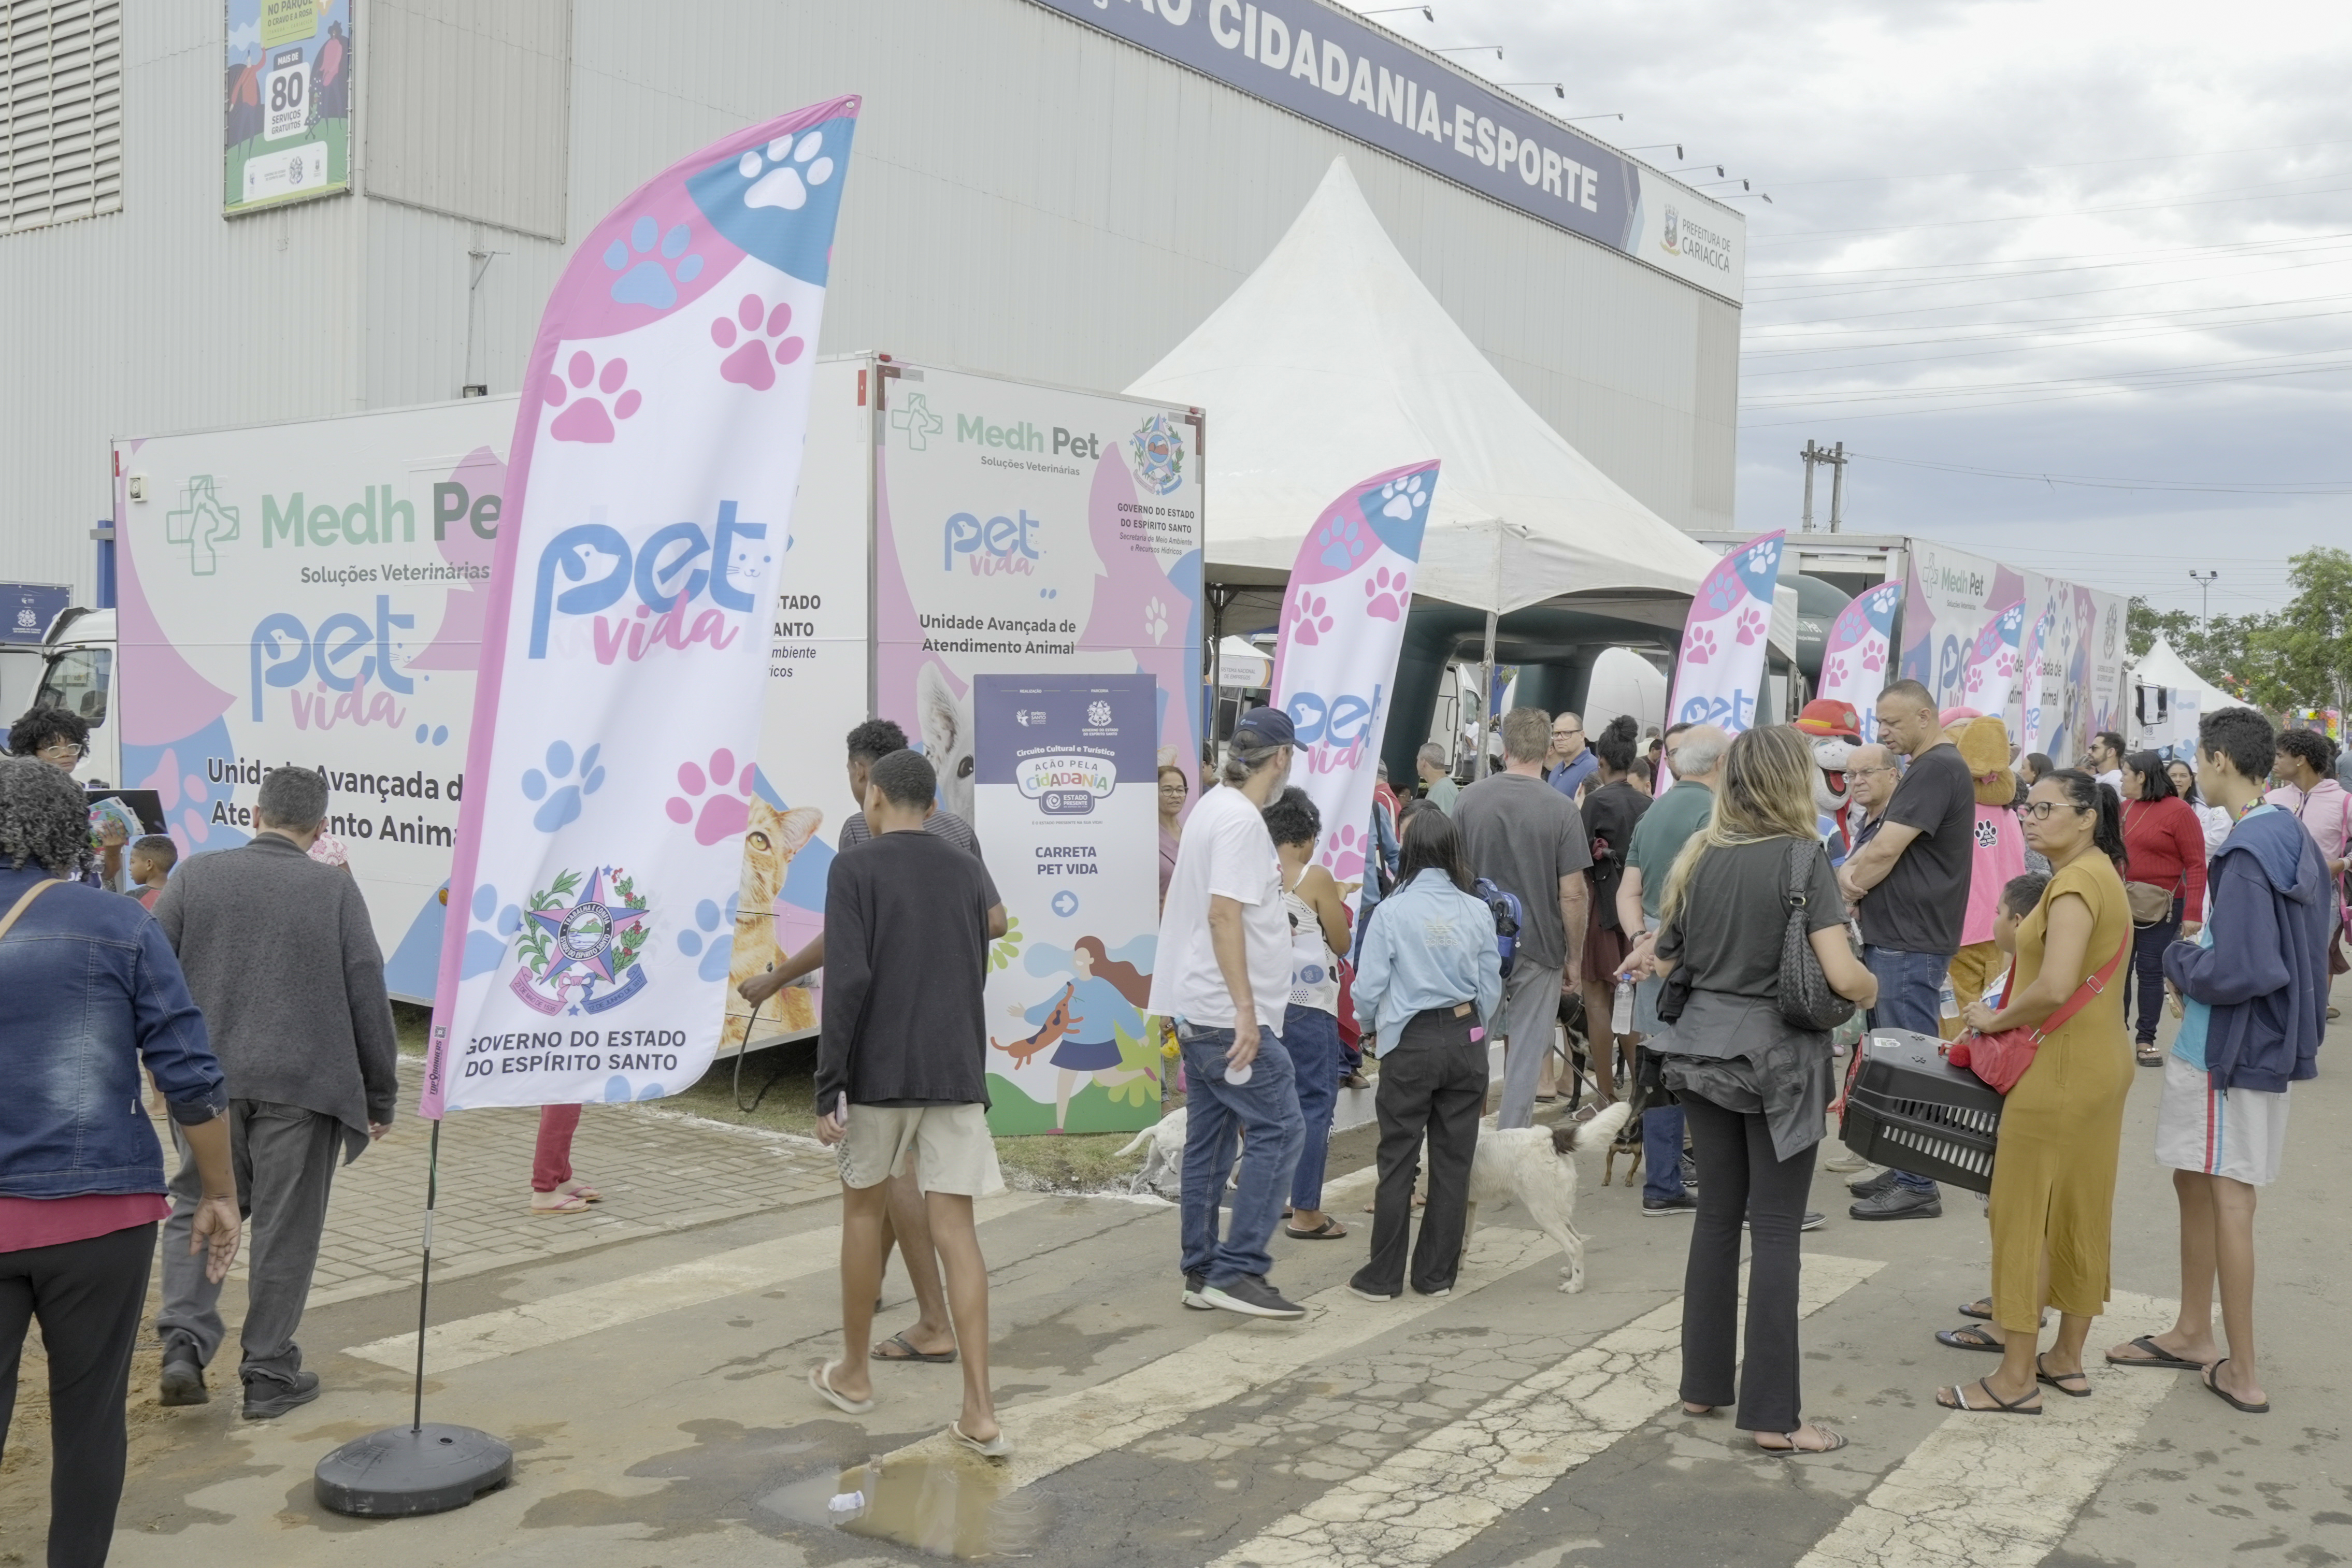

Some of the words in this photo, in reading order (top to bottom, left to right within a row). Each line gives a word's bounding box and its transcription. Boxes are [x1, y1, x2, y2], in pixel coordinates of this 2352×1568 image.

[268, 3, 279, 16] NO
[273, 15, 289, 25] CRAVO
[299, 8, 312, 18] ROSA
[278, 55, 290, 65] MAIS
[291, 52, 299, 61] DE
[271, 71, 303, 112] 80
[272, 109, 300, 125] SERVIÇOS
[271, 121, 300, 135] GRATUITOS
[1683, 219, 1720, 248] PREFEITURA
[1722, 238, 1730, 252] DE
[1682, 237, 1729, 273] CARIACICA
[957, 413, 1044, 453] Medh
[1053, 427, 1100, 460] Pet
[981, 456, 1024, 469] Soluções
[1026, 461, 1080, 476] Veterinárias
[261, 484, 415, 549] Medh
[433, 481, 503, 541] Pe
[1117, 502, 1153, 515] GOVERNO
[1156, 507, 1165, 516] DO
[1167, 508, 1195, 519] ESTADO
[1121, 519, 1131, 527] DO
[1134, 519, 1166, 531] ESPÍRITO
[1168, 523, 1192, 533] SANTO
[1120, 532, 1146, 542] Secretaria
[1168, 537, 1193, 546] Ambiente
[1135, 544, 1160, 553] Recursos
[969, 548, 1035, 577] vida
[300, 564, 377, 587] Soluções
[381, 562, 490, 582] Veterinárias
[1941, 566, 1968, 594] Medh
[1969, 572, 1984, 597] Pet
[777, 595, 821, 610] TADO
[594, 589, 739, 666] vida
[774, 622, 814, 637] ANTO
[920, 613, 983, 629] Unidade
[987, 617, 1056, 635] Avançada
[1059, 620, 1076, 632] de
[772, 646, 816, 658] mbiente
[922, 638, 1022, 653] Atendimento
[1025, 640, 1074, 654] Animal
[291, 673, 406, 730] vida
[2041, 687, 2059, 706] nimal
[1016, 747, 1045, 756] Circuito
[1083, 745, 1115, 756] Turístico
[1035, 759, 1064, 771] AÇÃO
[1070, 760, 1097, 771] PELA
[1035, 846, 1097, 858] CARRETA
[1038, 864, 1063, 875] PET
[1066, 864, 1098, 874] VIDA
[564, 904, 591, 926] TRABALHA
[595, 906, 610, 925] CONFIA
[560, 936, 570, 953] ESTADO
[568, 949, 576, 957] DO
[597, 933, 610, 951] SANTO
[520, 986, 527, 995] DE
[525, 992, 536, 1003] MAIO
[543, 1003, 556, 1012] 1535
[606, 992, 624, 1005] JUNHO
[624, 986, 633, 995] DE
[466, 1031, 562, 1055] GOVERNO
[570, 1031, 599, 1047] DO
[607, 1030, 686, 1047] ESTADO
[465, 1059, 493, 1077] DO
[501, 1052, 600, 1073] ESPÍRITO
[608, 1054, 677, 1071] SANTO
